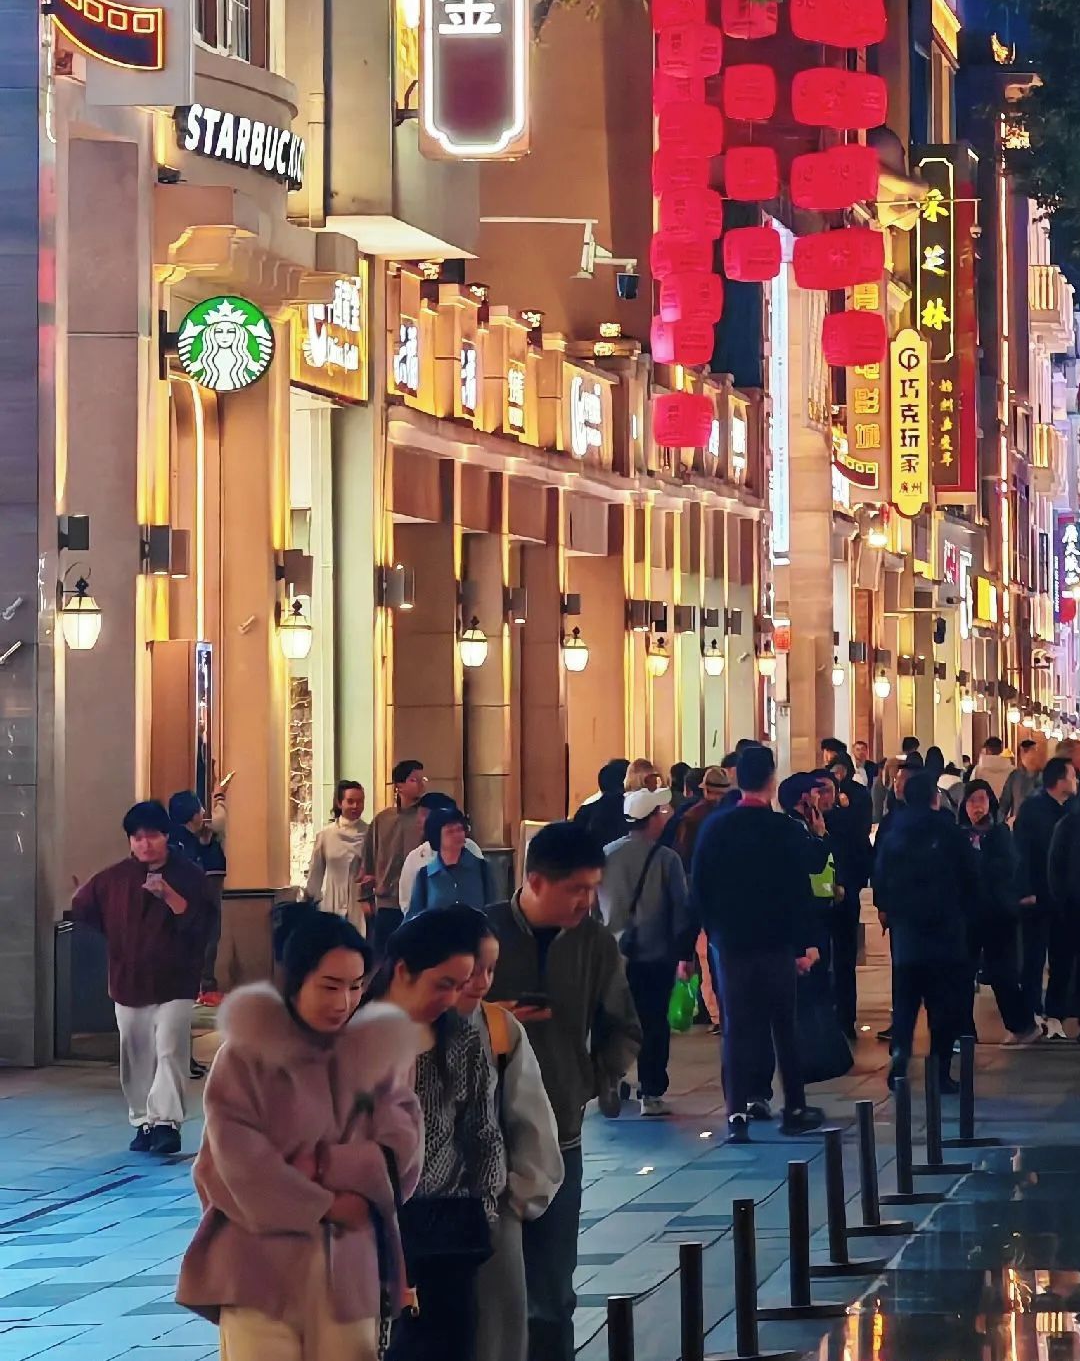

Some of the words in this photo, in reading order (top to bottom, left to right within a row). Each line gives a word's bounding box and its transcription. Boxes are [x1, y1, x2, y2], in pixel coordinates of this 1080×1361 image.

[920, 188, 951, 331] 采芝林
[900, 378, 920, 474] 巧克玩家
